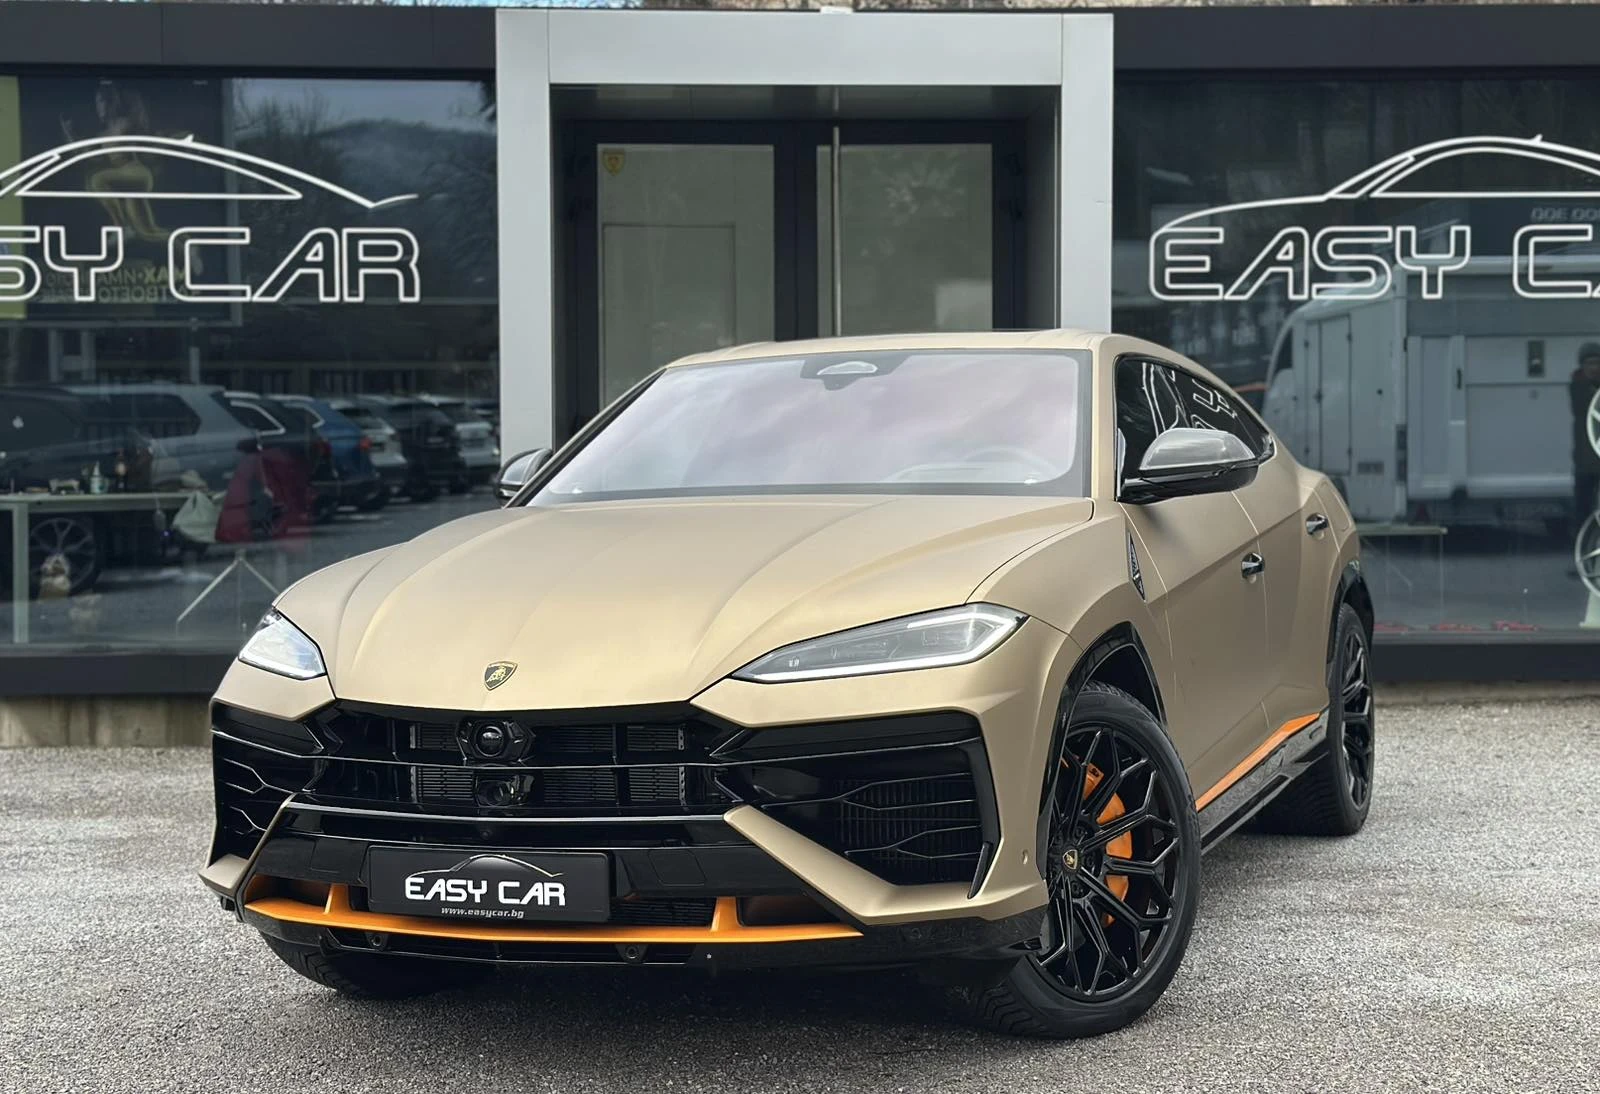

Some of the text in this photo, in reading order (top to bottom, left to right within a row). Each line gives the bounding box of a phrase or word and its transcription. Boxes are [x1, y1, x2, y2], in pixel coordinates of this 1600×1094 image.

[168, 227, 420, 302] CAR
[1149, 224, 1600, 300] EASY C
[405, 877, 566, 906] EASY CAR
[441, 906, 524, 919] www.easycar.bg
